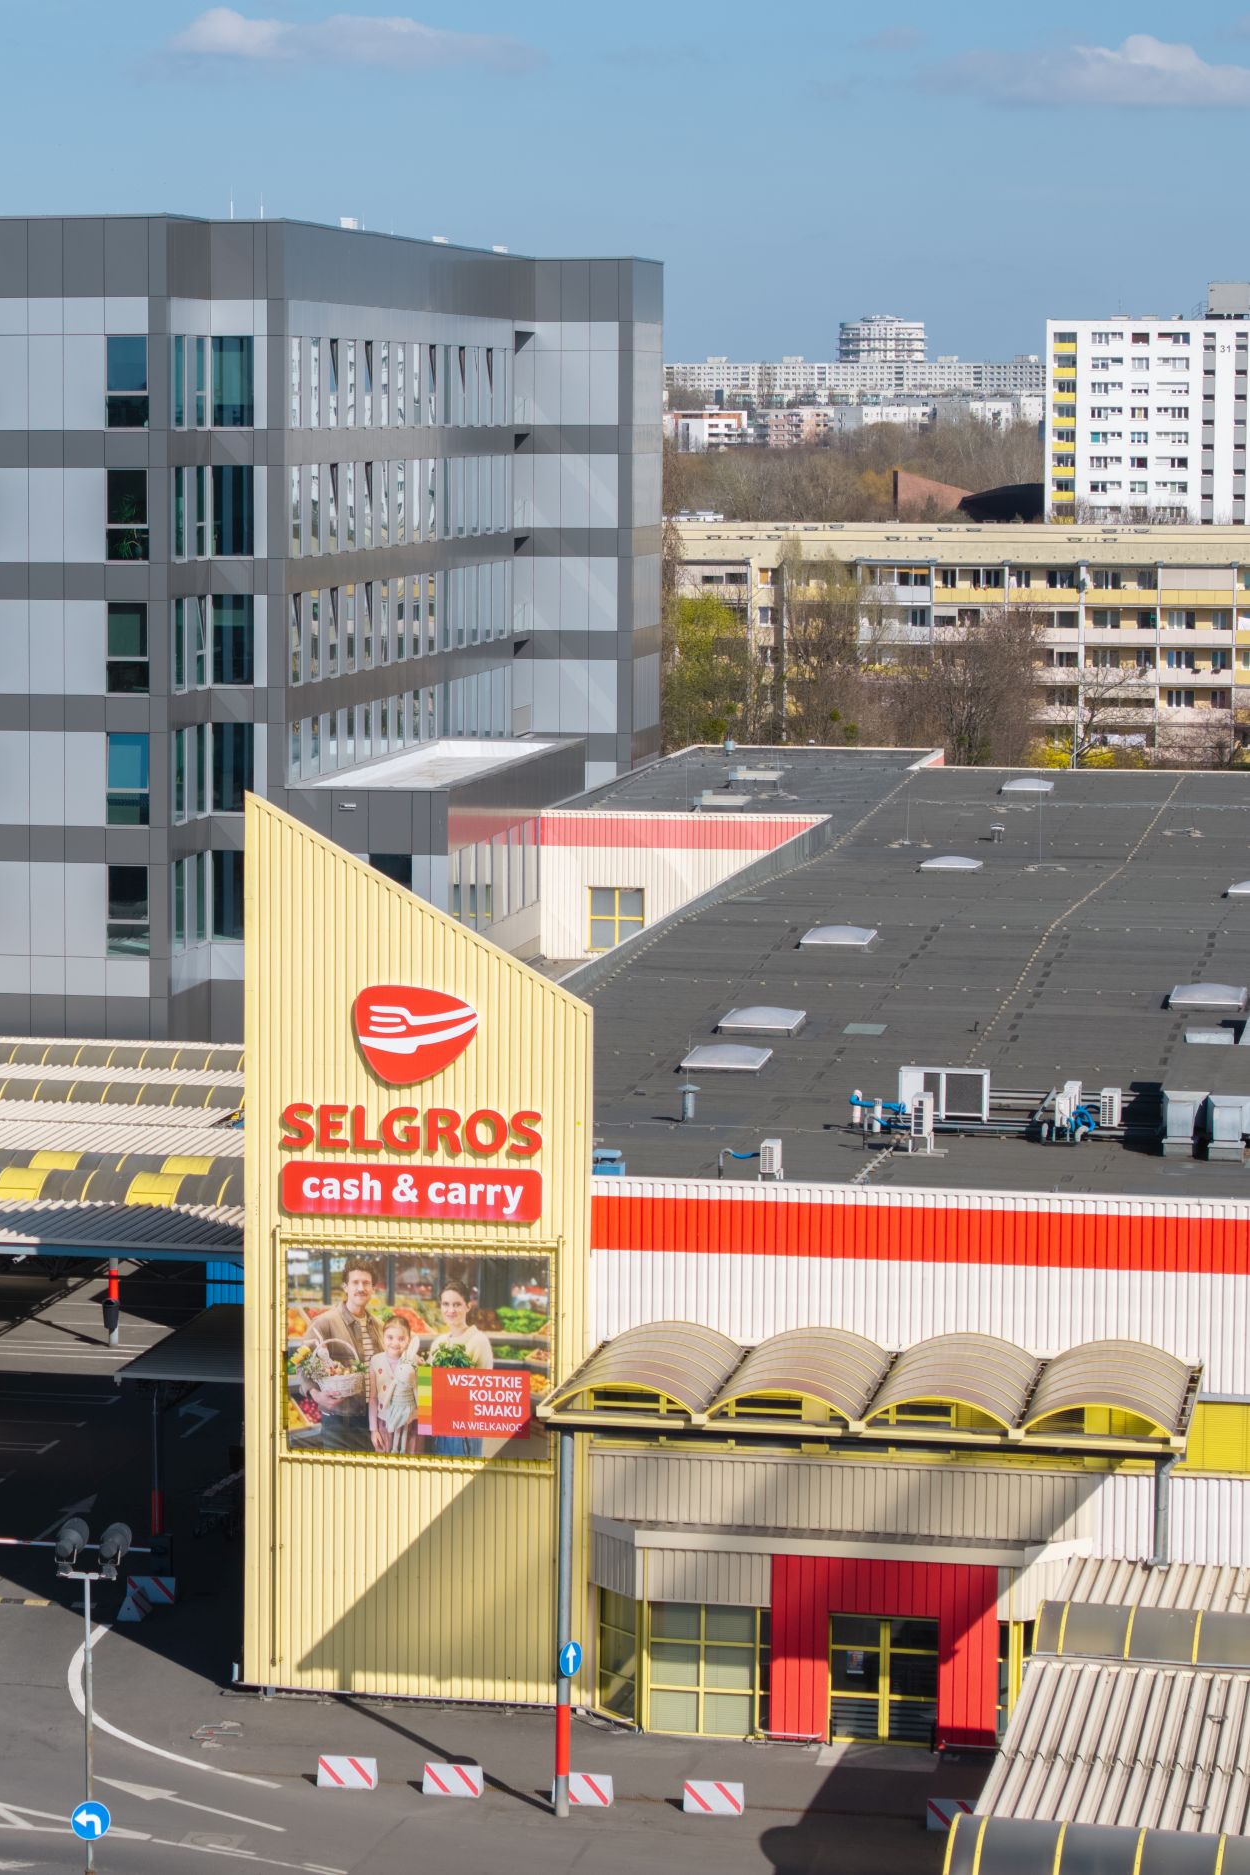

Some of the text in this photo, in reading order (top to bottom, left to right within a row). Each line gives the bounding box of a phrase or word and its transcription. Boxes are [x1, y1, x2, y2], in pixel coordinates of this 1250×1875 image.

[1219, 344, 1231, 353] 31
[281, 1102, 543, 1156] SELGROS
[302, 1172, 524, 1215] cash & carry
[447, 1374, 522, 1389] WSZYSTKIE
[469, 1390, 522, 1403] KOLORY
[474, 1404, 522, 1418] SMAKU
[452, 1421, 522, 1432] NA WIELKANOC
